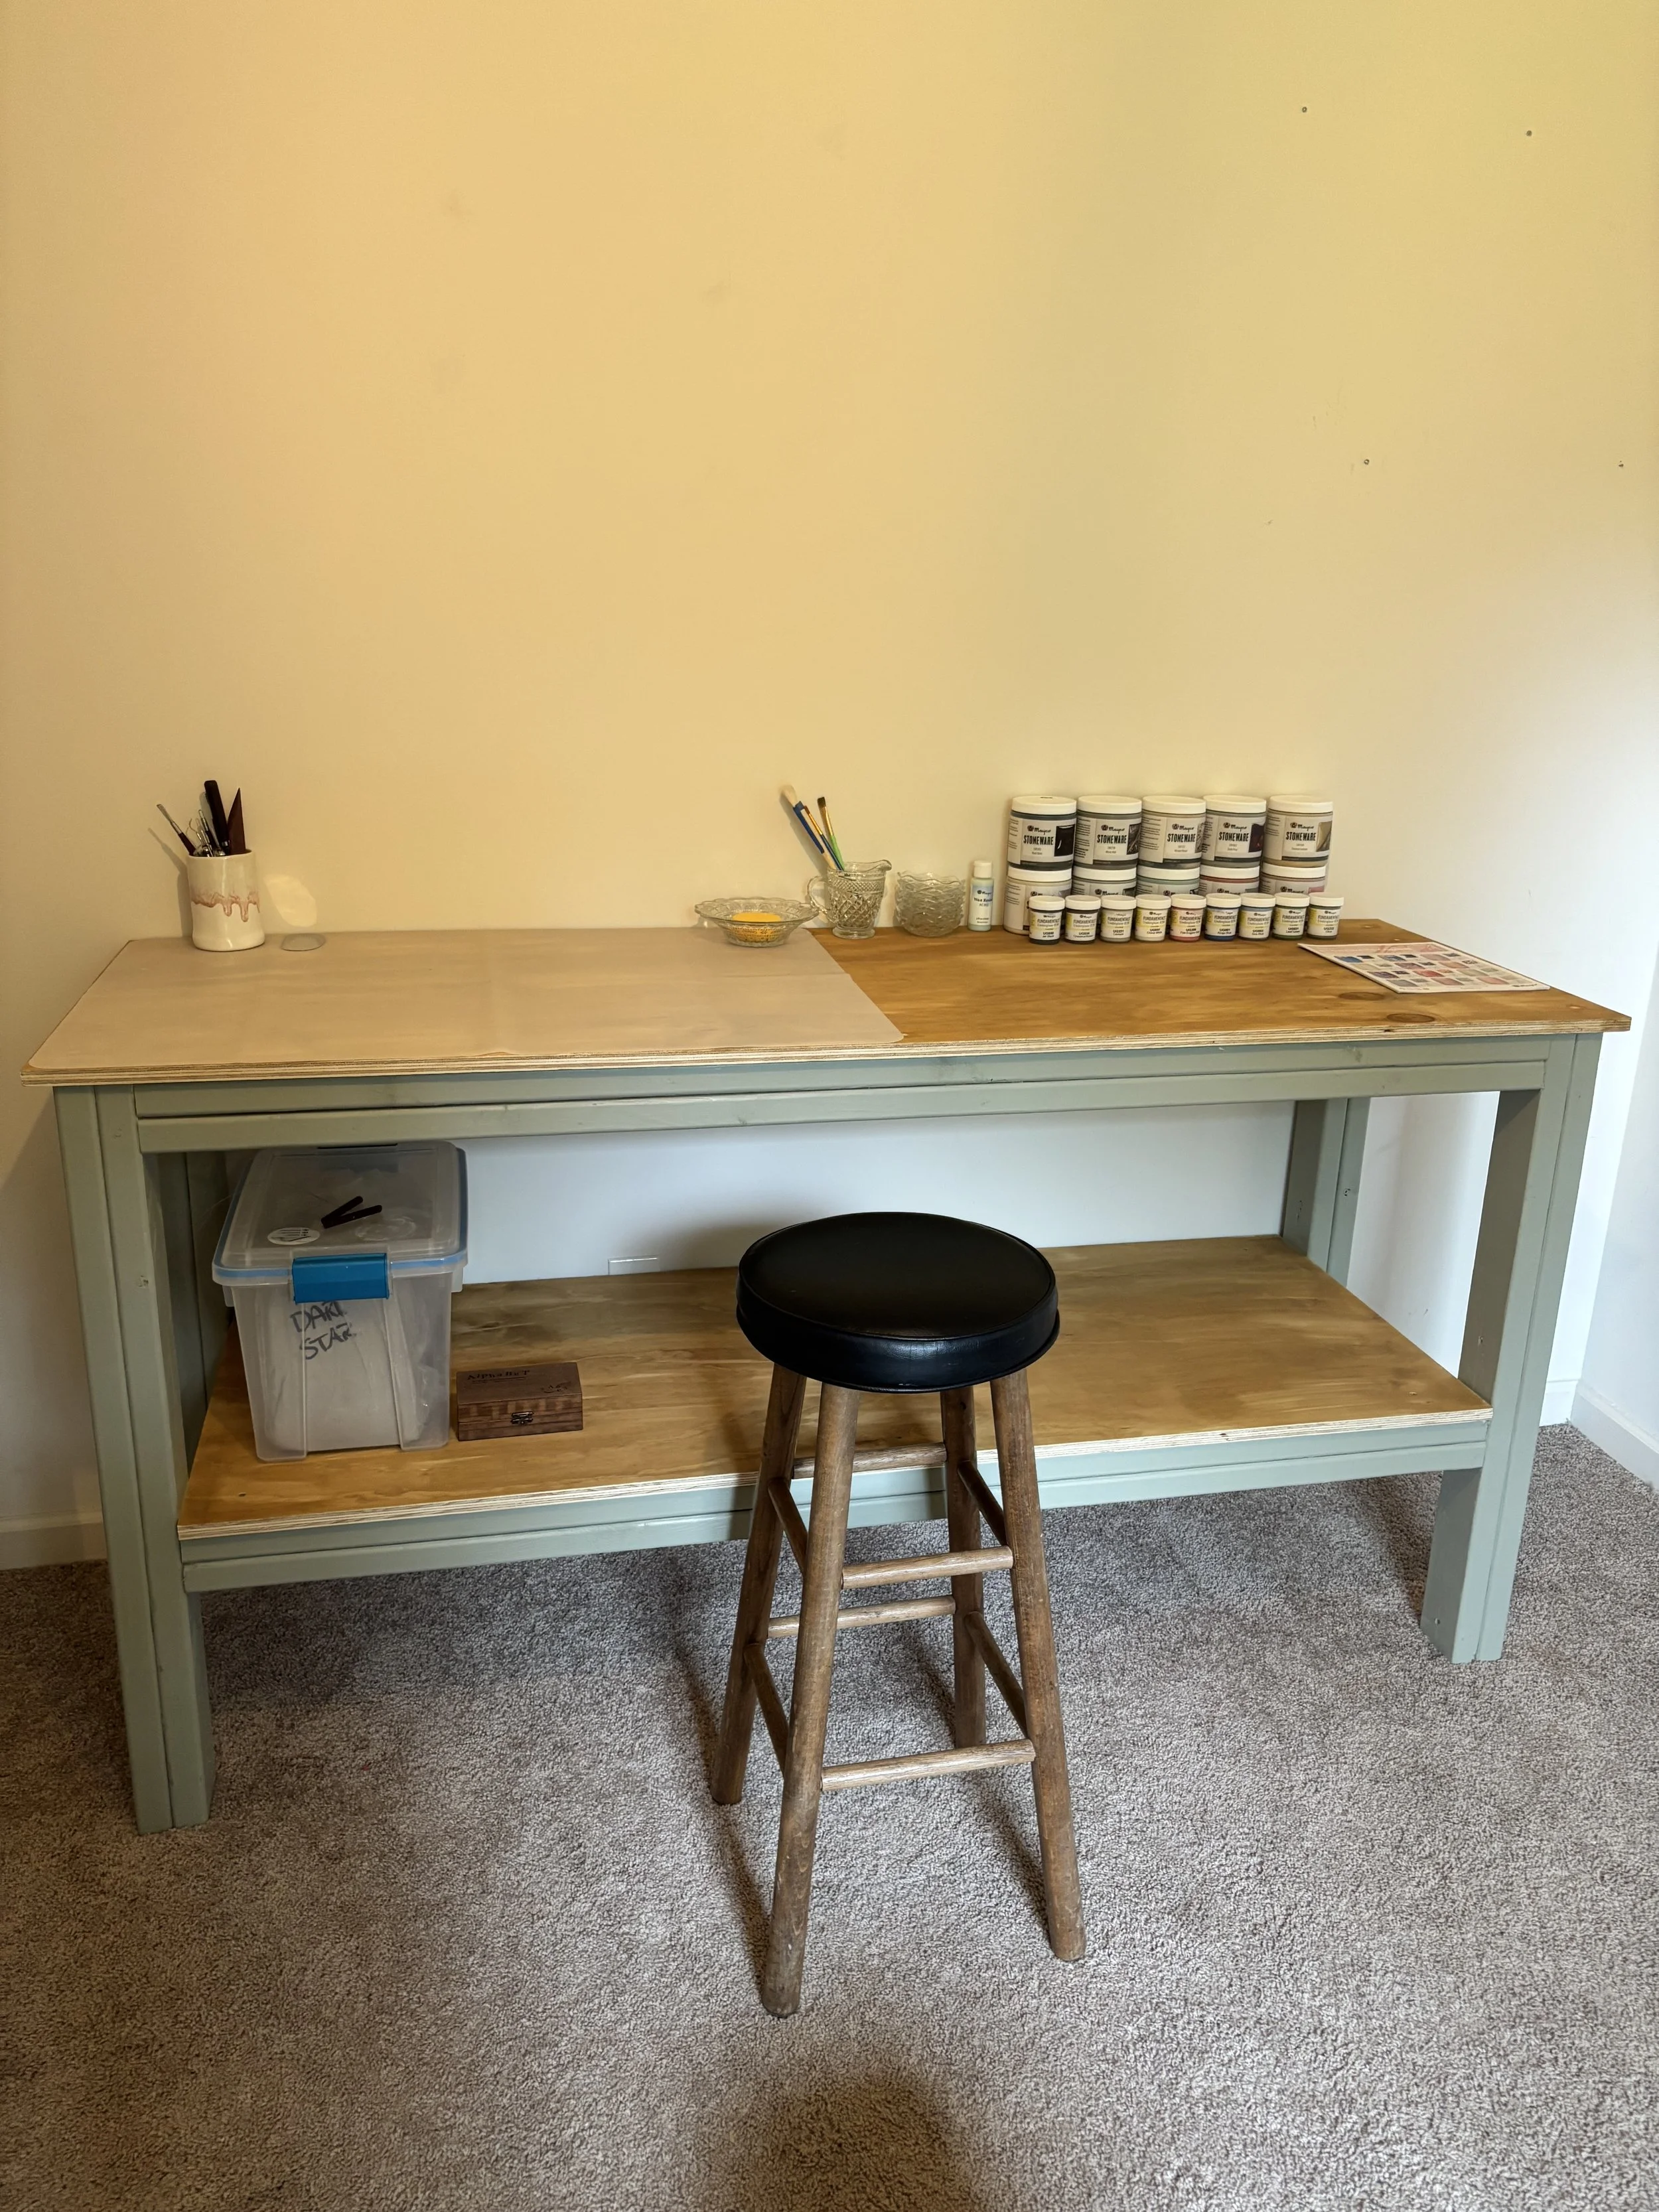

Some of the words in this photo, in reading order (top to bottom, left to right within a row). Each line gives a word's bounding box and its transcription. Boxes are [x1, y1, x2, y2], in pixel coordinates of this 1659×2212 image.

[1023, 835, 1054, 846] STONEWARE
[1097, 834, 1127, 844] STONEWARE
[1167, 834, 1196, 842] STONEWARE
[1218, 832, 1249, 842] STONEWARE
[1285, 832, 1317, 841] STONEWARE
